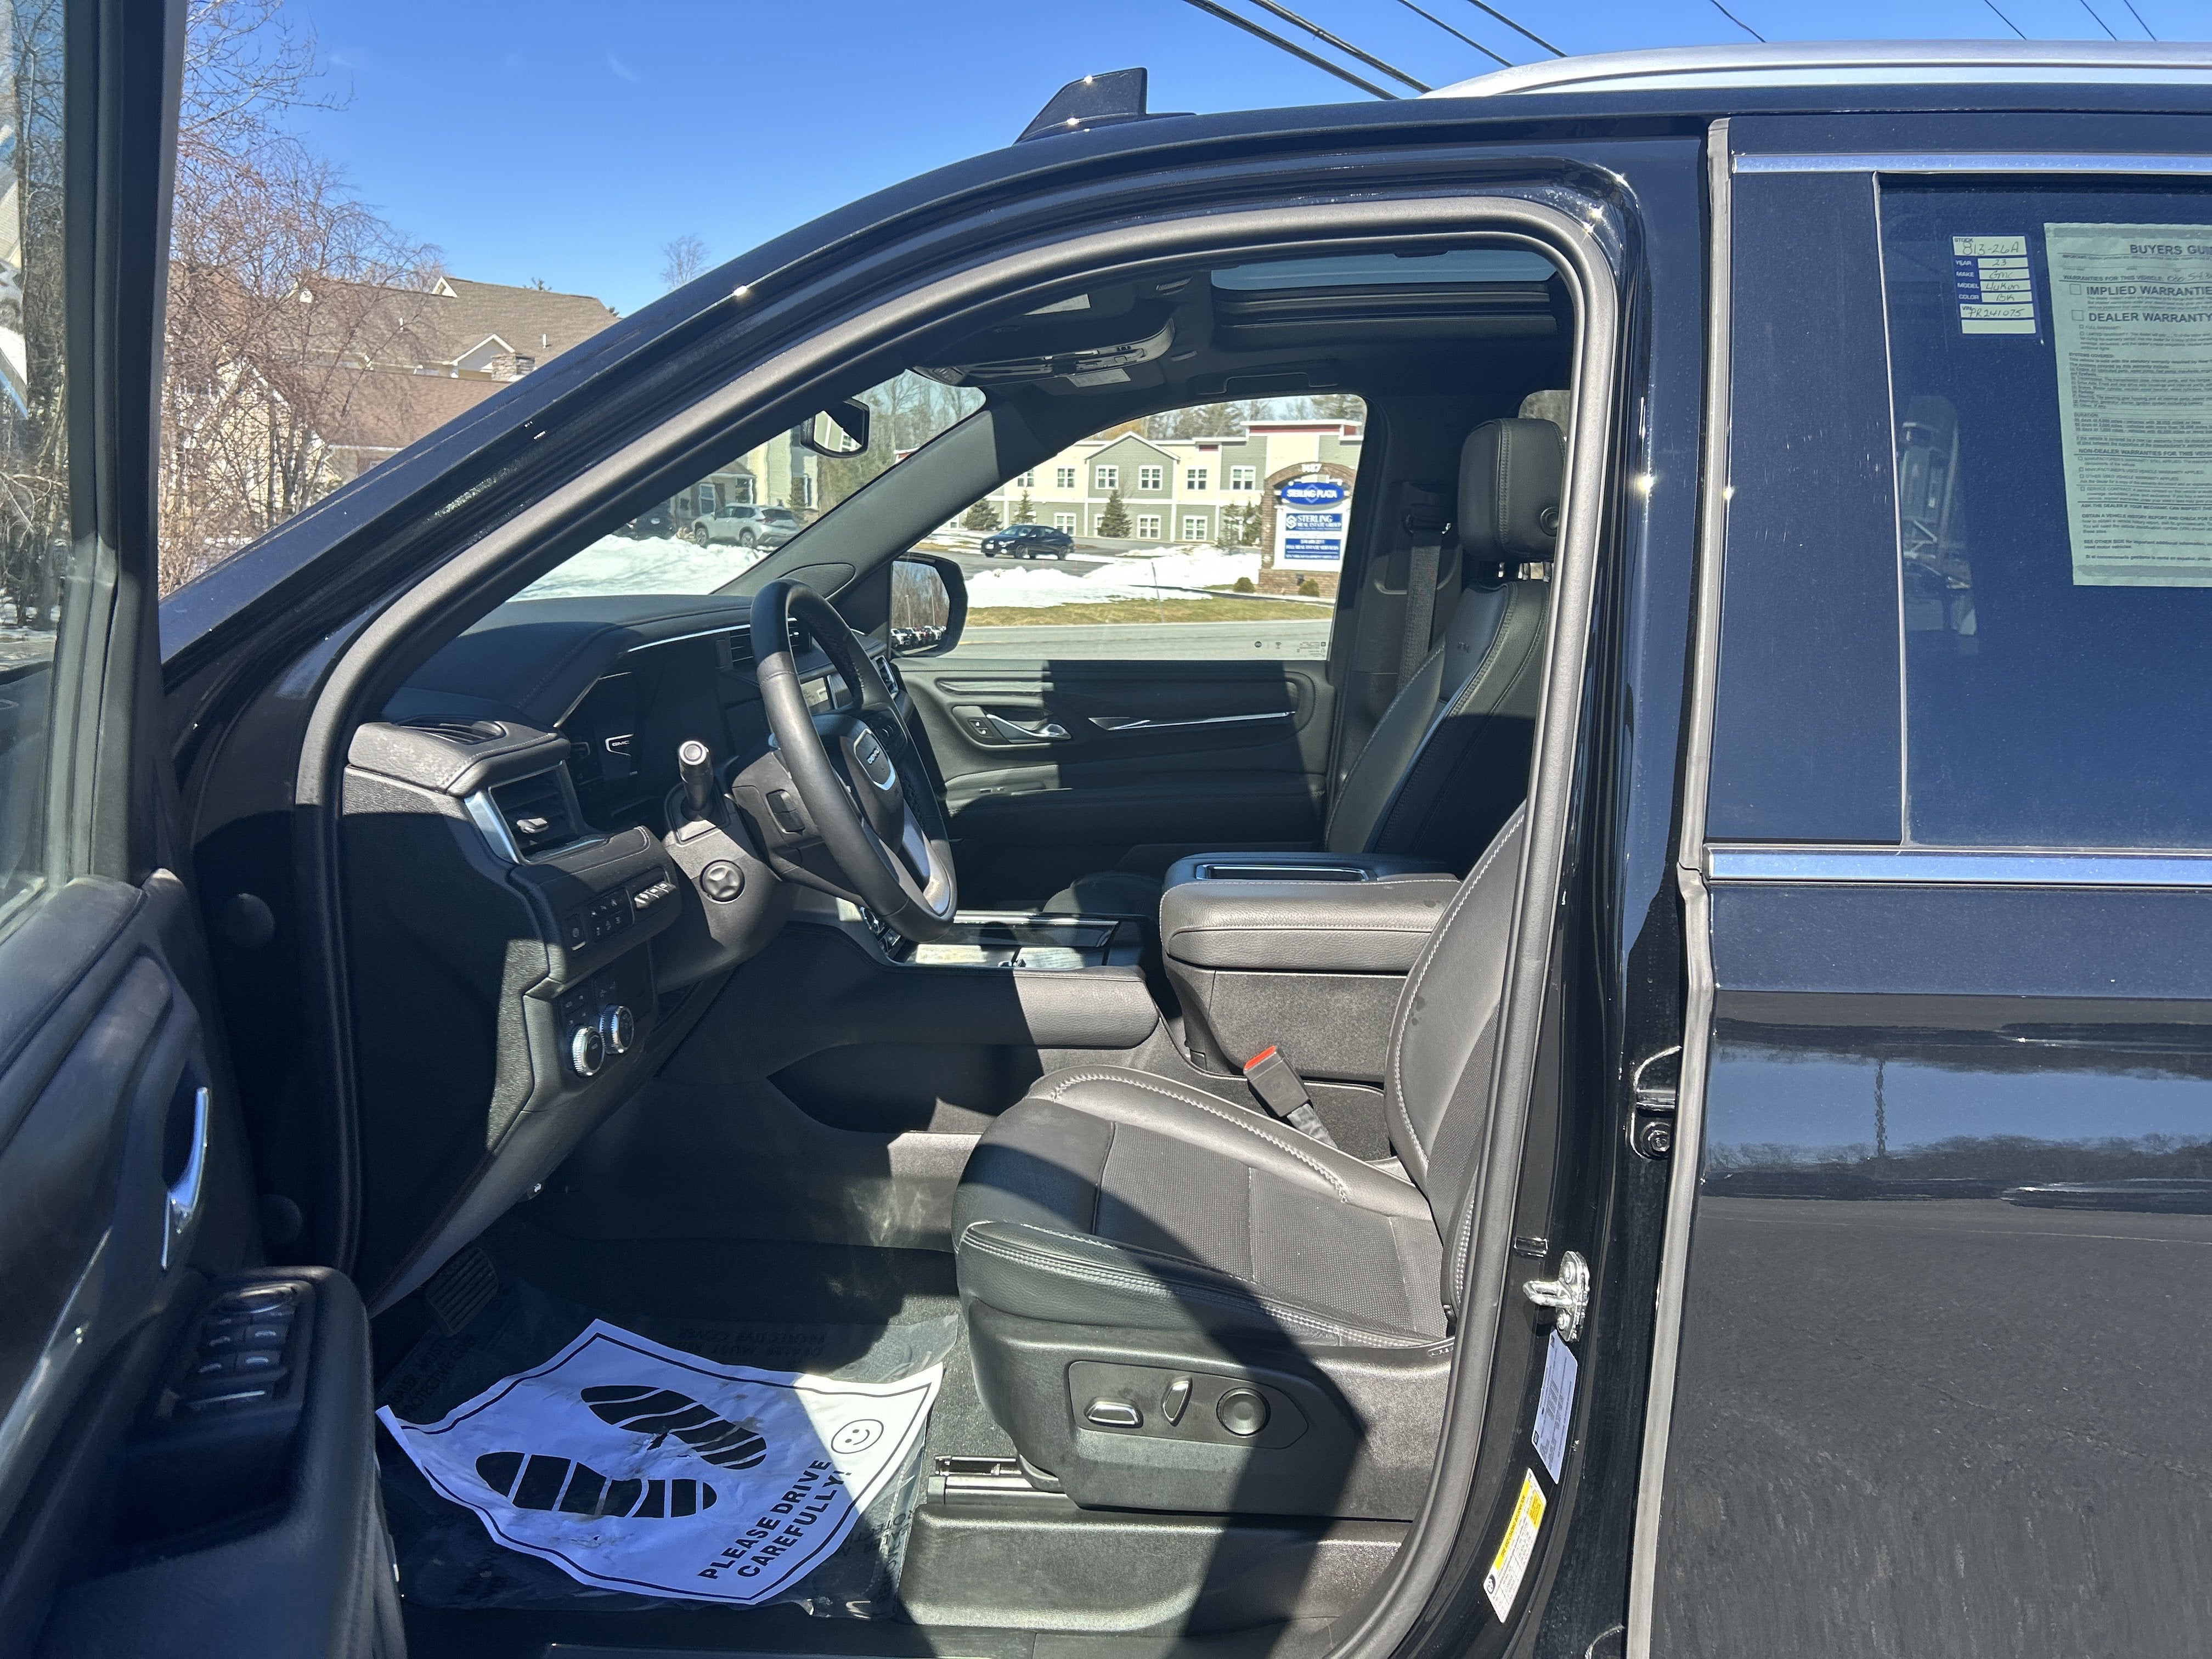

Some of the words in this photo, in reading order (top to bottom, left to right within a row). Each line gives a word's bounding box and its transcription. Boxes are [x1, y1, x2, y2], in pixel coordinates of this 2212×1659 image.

[1962, 241, 2019, 255] 813-26A
[2130, 245, 2183, 255] BUYERS
[2086, 286, 2137, 295] IMPLIED
[2089, 313, 2139, 322] DEALER
[1287, 489, 1317, 498] STERLING
[1317, 489, 1338, 498] PLAZA
[1297, 515, 1334, 523] STERLING
[697, 1517, 781, 1579] PLEASE
[770, 1460, 832, 1514] DRIVE
[737, 1470, 852, 1577] CAREFULLY!
